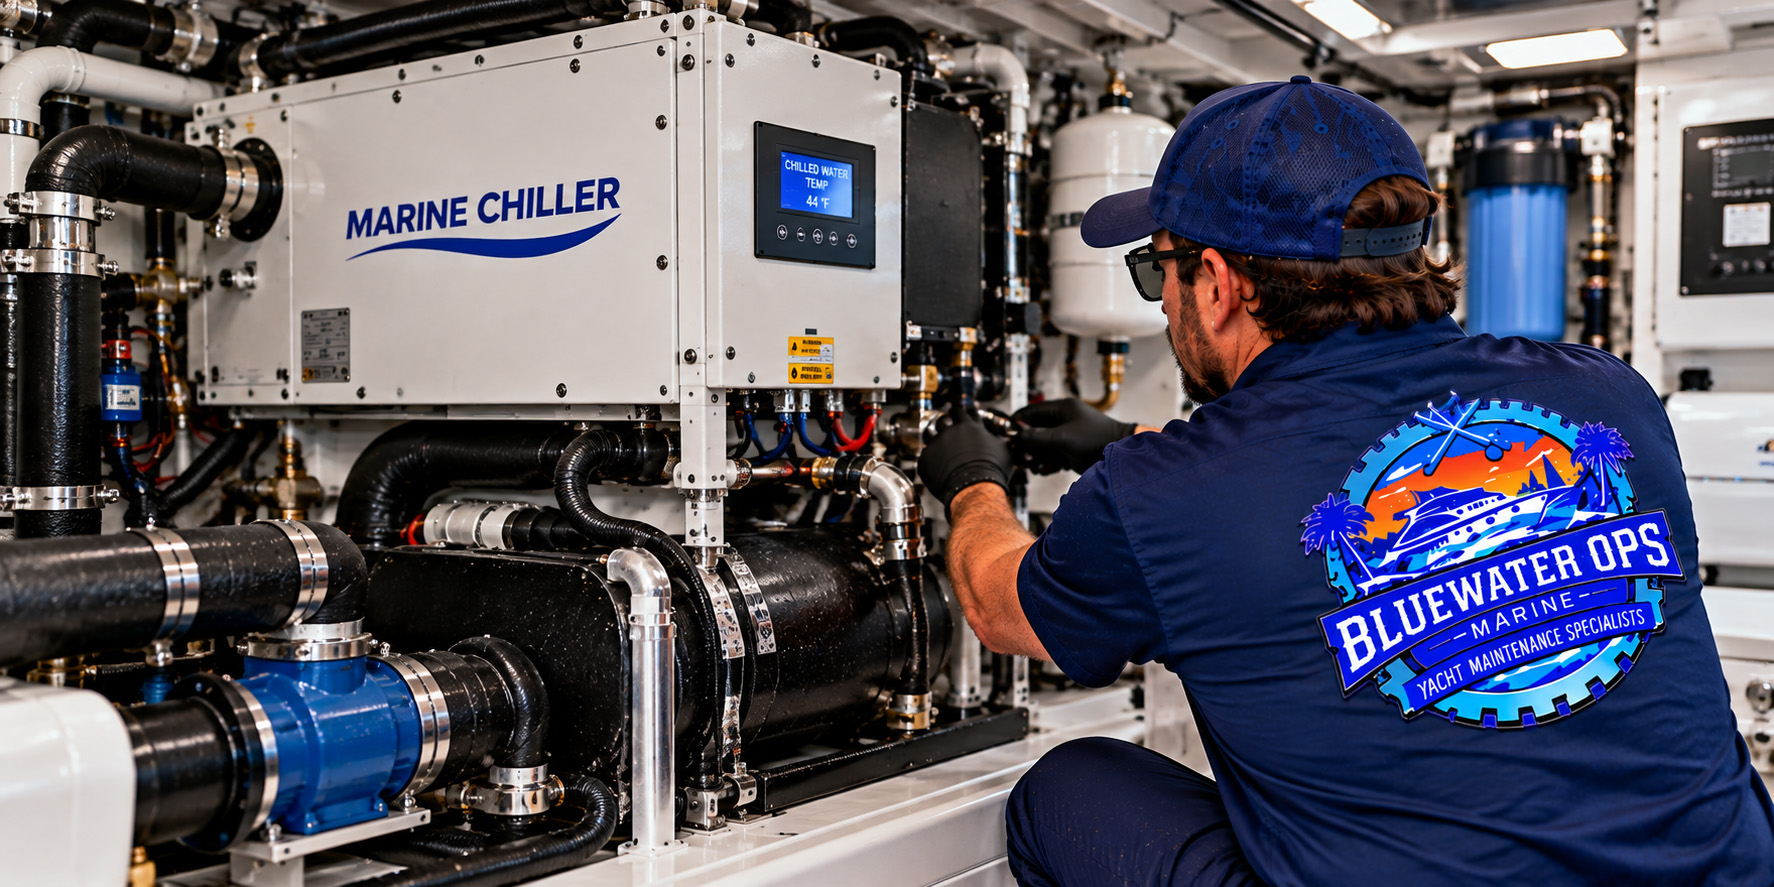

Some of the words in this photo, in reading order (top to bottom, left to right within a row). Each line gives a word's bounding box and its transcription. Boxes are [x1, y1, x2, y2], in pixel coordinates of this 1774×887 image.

[785, 159, 819, 175] CHILLED
[821, 165, 849, 180] WATER
[805, 177, 829, 190] TEMP
[346, 196, 468, 240] MARINE
[477, 176, 621, 224] CHILLER
[806, 195, 818, 208] 44
[1336, 545, 1582, 673] BLUEWATER
[1587, 522, 1670, 572] OPS
[1470, 592, 1575, 639] MARINE
[1417, 663, 1461, 700] YACHT
[1468, 628, 1564, 676] MAINTENANCE
[1565, 608, 1645, 641] SPECIALISTS
